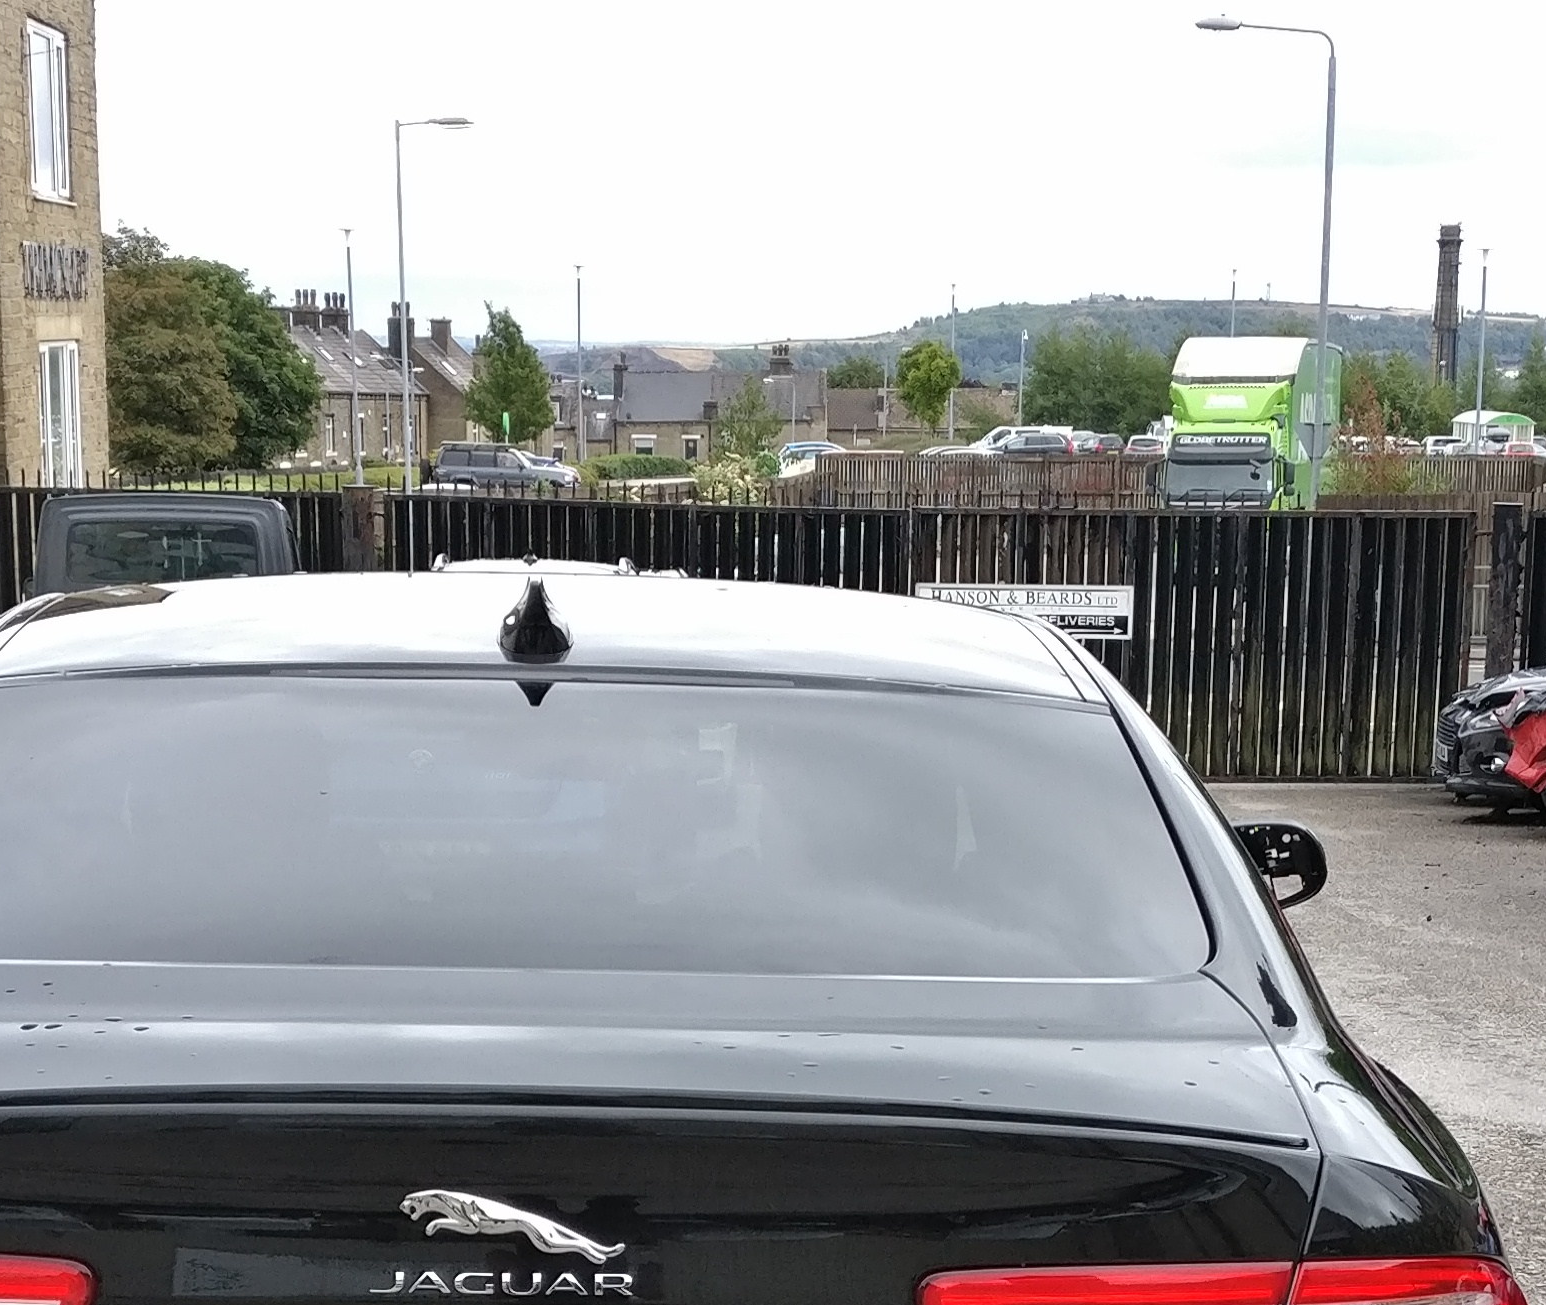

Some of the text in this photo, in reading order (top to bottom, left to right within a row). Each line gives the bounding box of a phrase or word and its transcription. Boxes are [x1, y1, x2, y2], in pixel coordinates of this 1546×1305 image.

[1176, 434, 1267, 445] GLOBETROTTER
[932, 589, 1118, 606] HANSON & BEARDS LTD
[369, 1271, 634, 1296] JAGUAR
